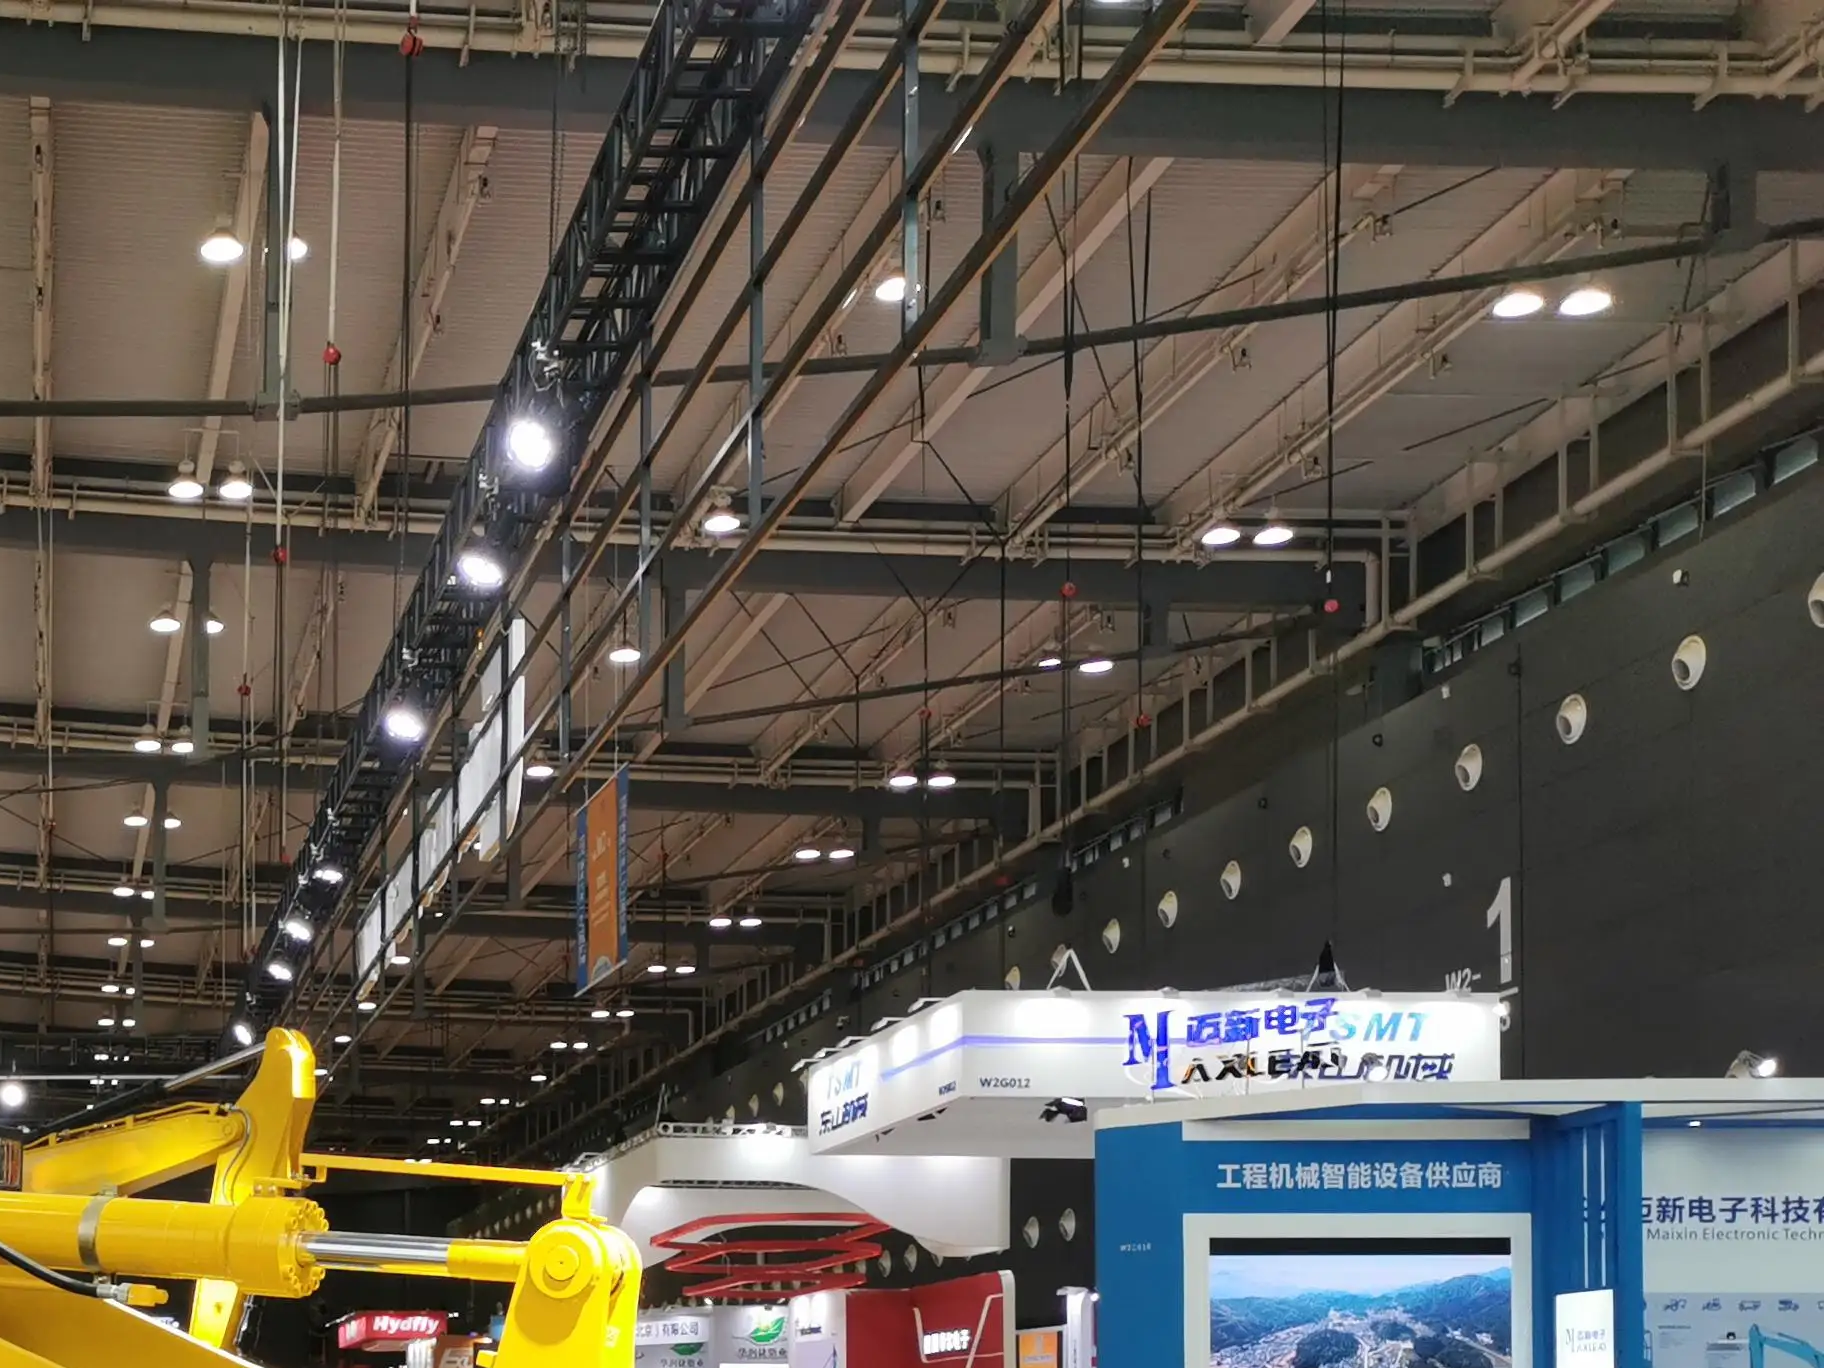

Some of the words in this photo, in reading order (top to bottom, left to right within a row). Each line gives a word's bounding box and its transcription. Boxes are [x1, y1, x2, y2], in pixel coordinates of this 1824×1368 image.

[1186, 997, 1340, 1048] 迈新电子
[979, 1077, 1031, 1089] W2G012
[1216, 1162, 1503, 1190] 工程机械智能设备供应商
[1703, 1227, 1779, 1241] Electronic
[373, 1315, 440, 1335] Hydfly
